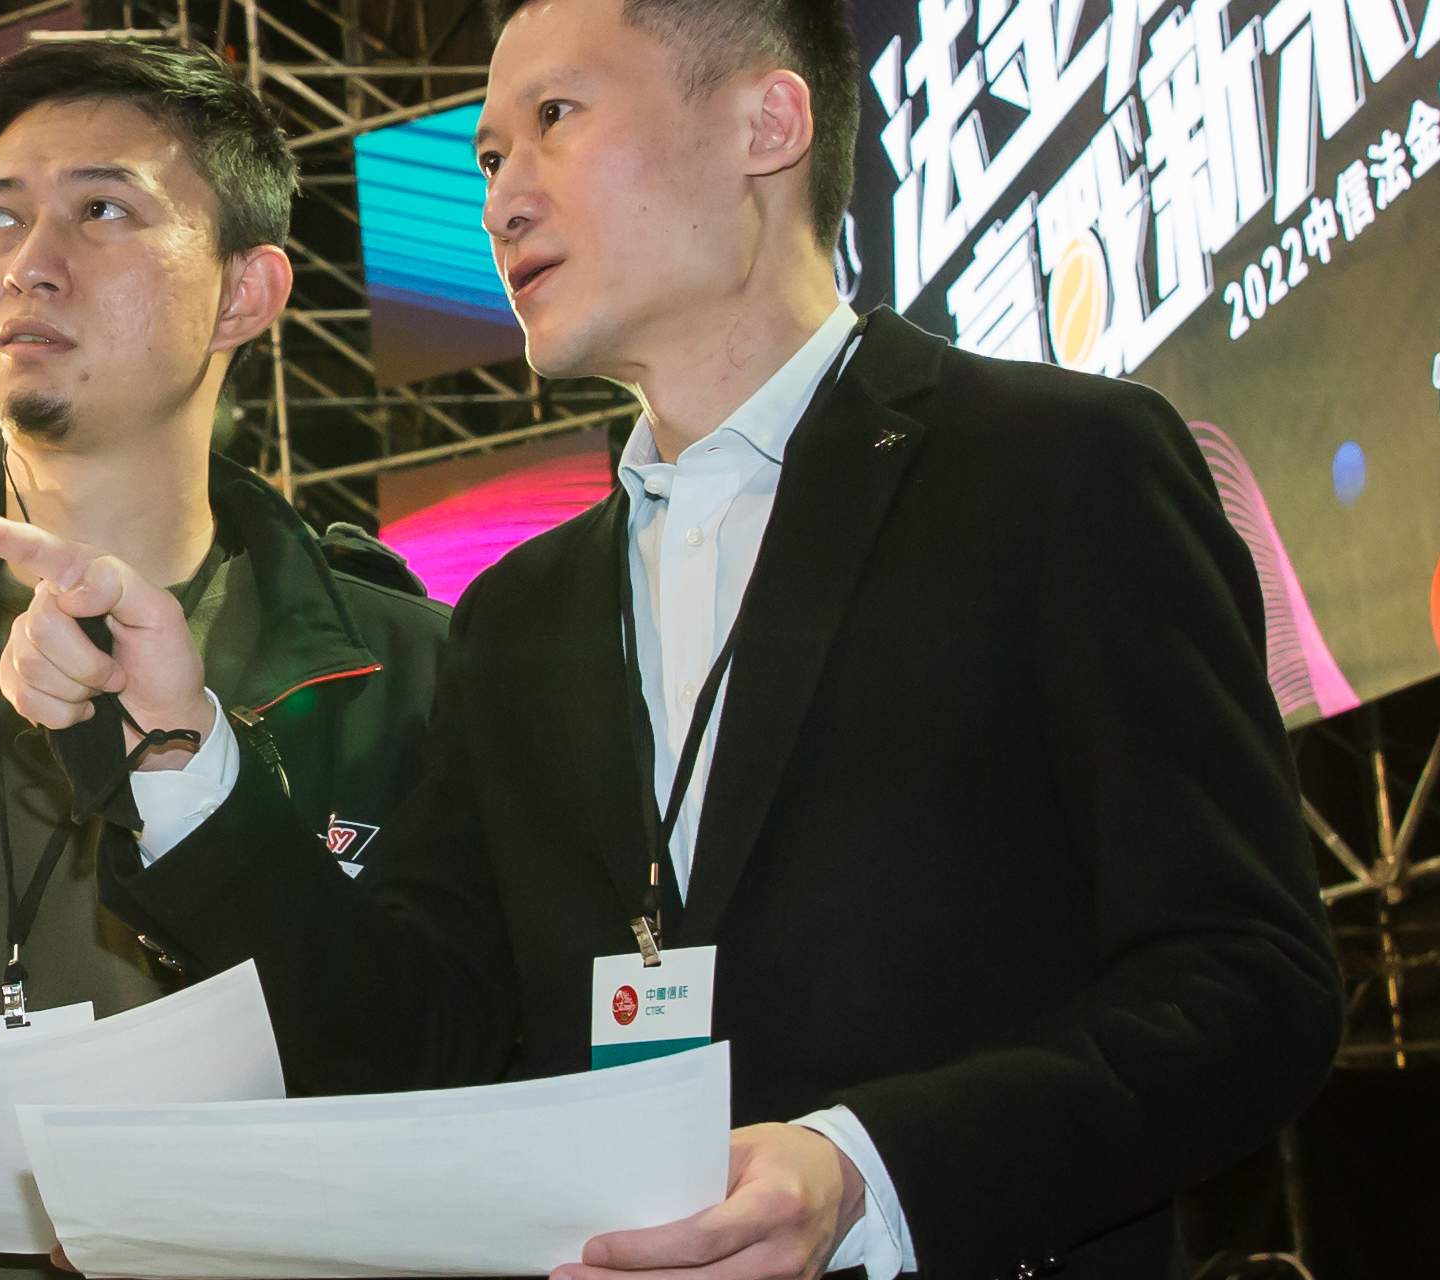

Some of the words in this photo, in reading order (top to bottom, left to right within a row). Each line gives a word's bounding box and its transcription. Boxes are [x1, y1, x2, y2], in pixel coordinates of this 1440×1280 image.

[645, 985, 689, 1001] 中國信託
[645, 1005, 666, 1016] CTBC
